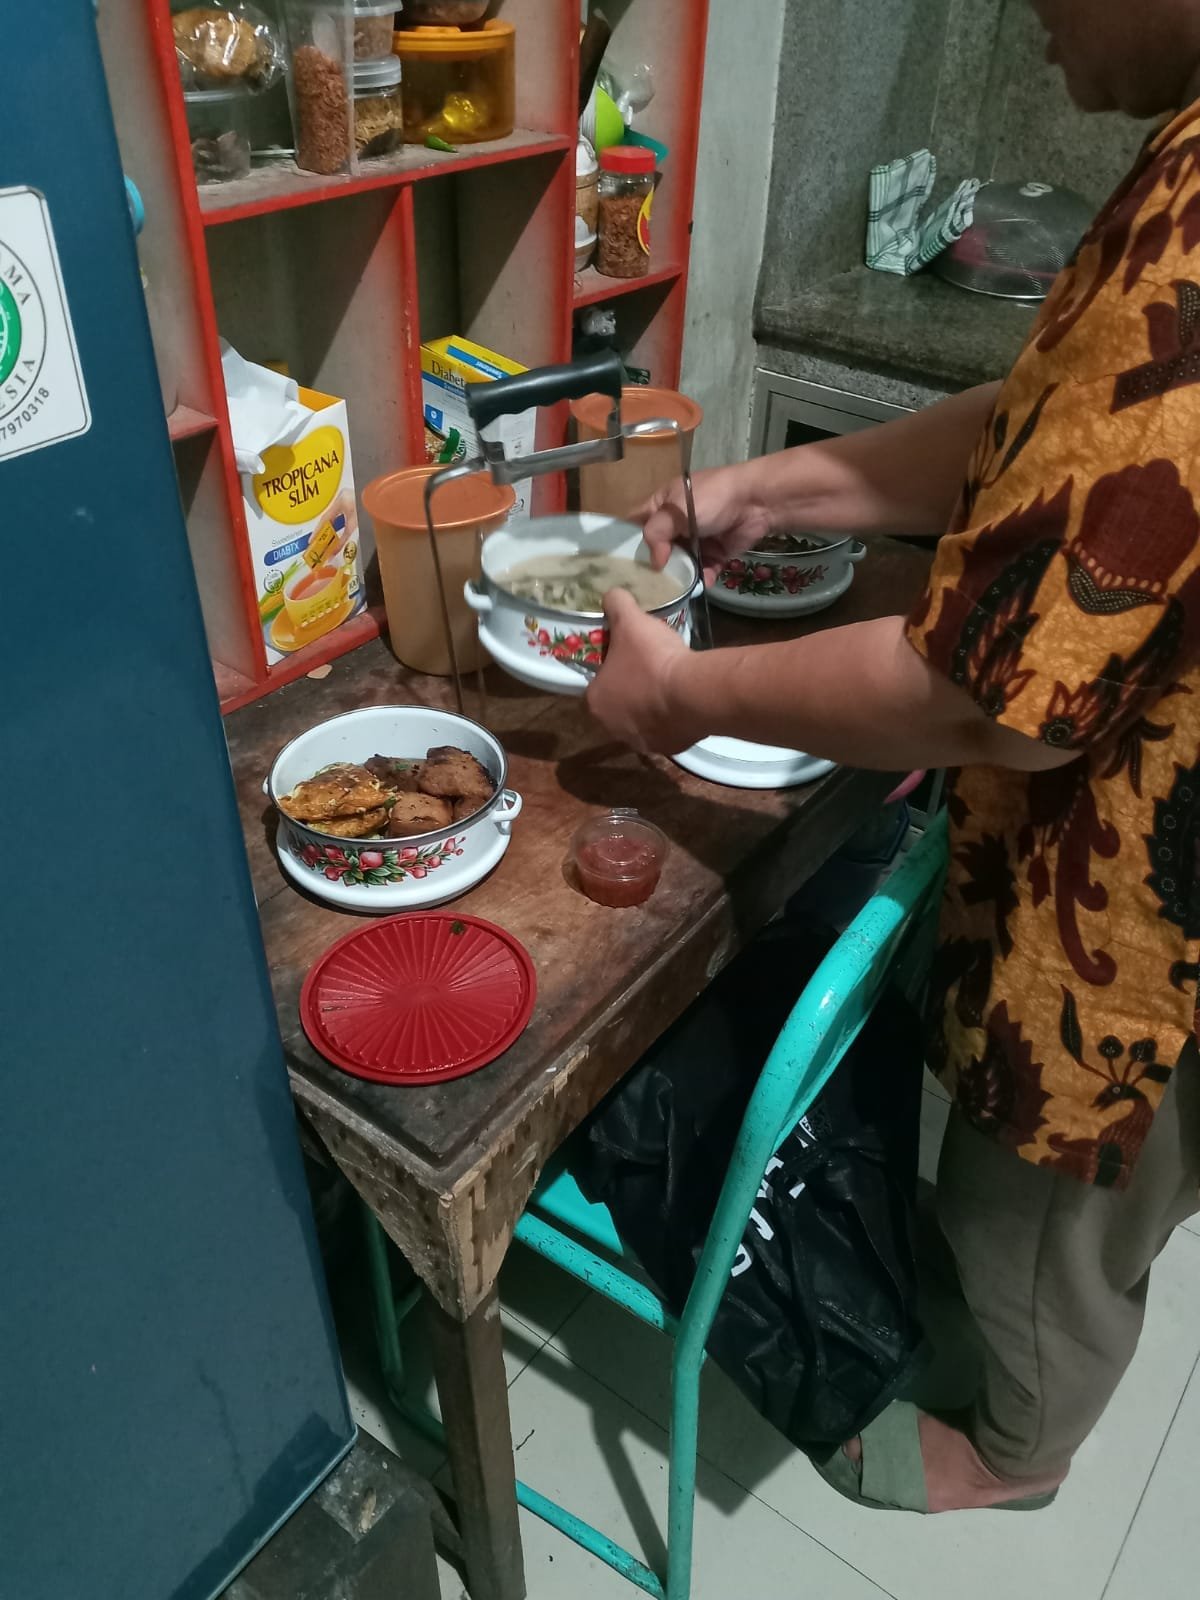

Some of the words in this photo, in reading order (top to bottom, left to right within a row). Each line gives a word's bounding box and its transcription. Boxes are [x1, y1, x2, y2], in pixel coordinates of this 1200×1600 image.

[431, 360, 466, 388] Diabet
[0, 387, 50, 441] 7970318
[262, 449, 340, 500] TROPICANA
[288, 482, 320, 509] SLIM
